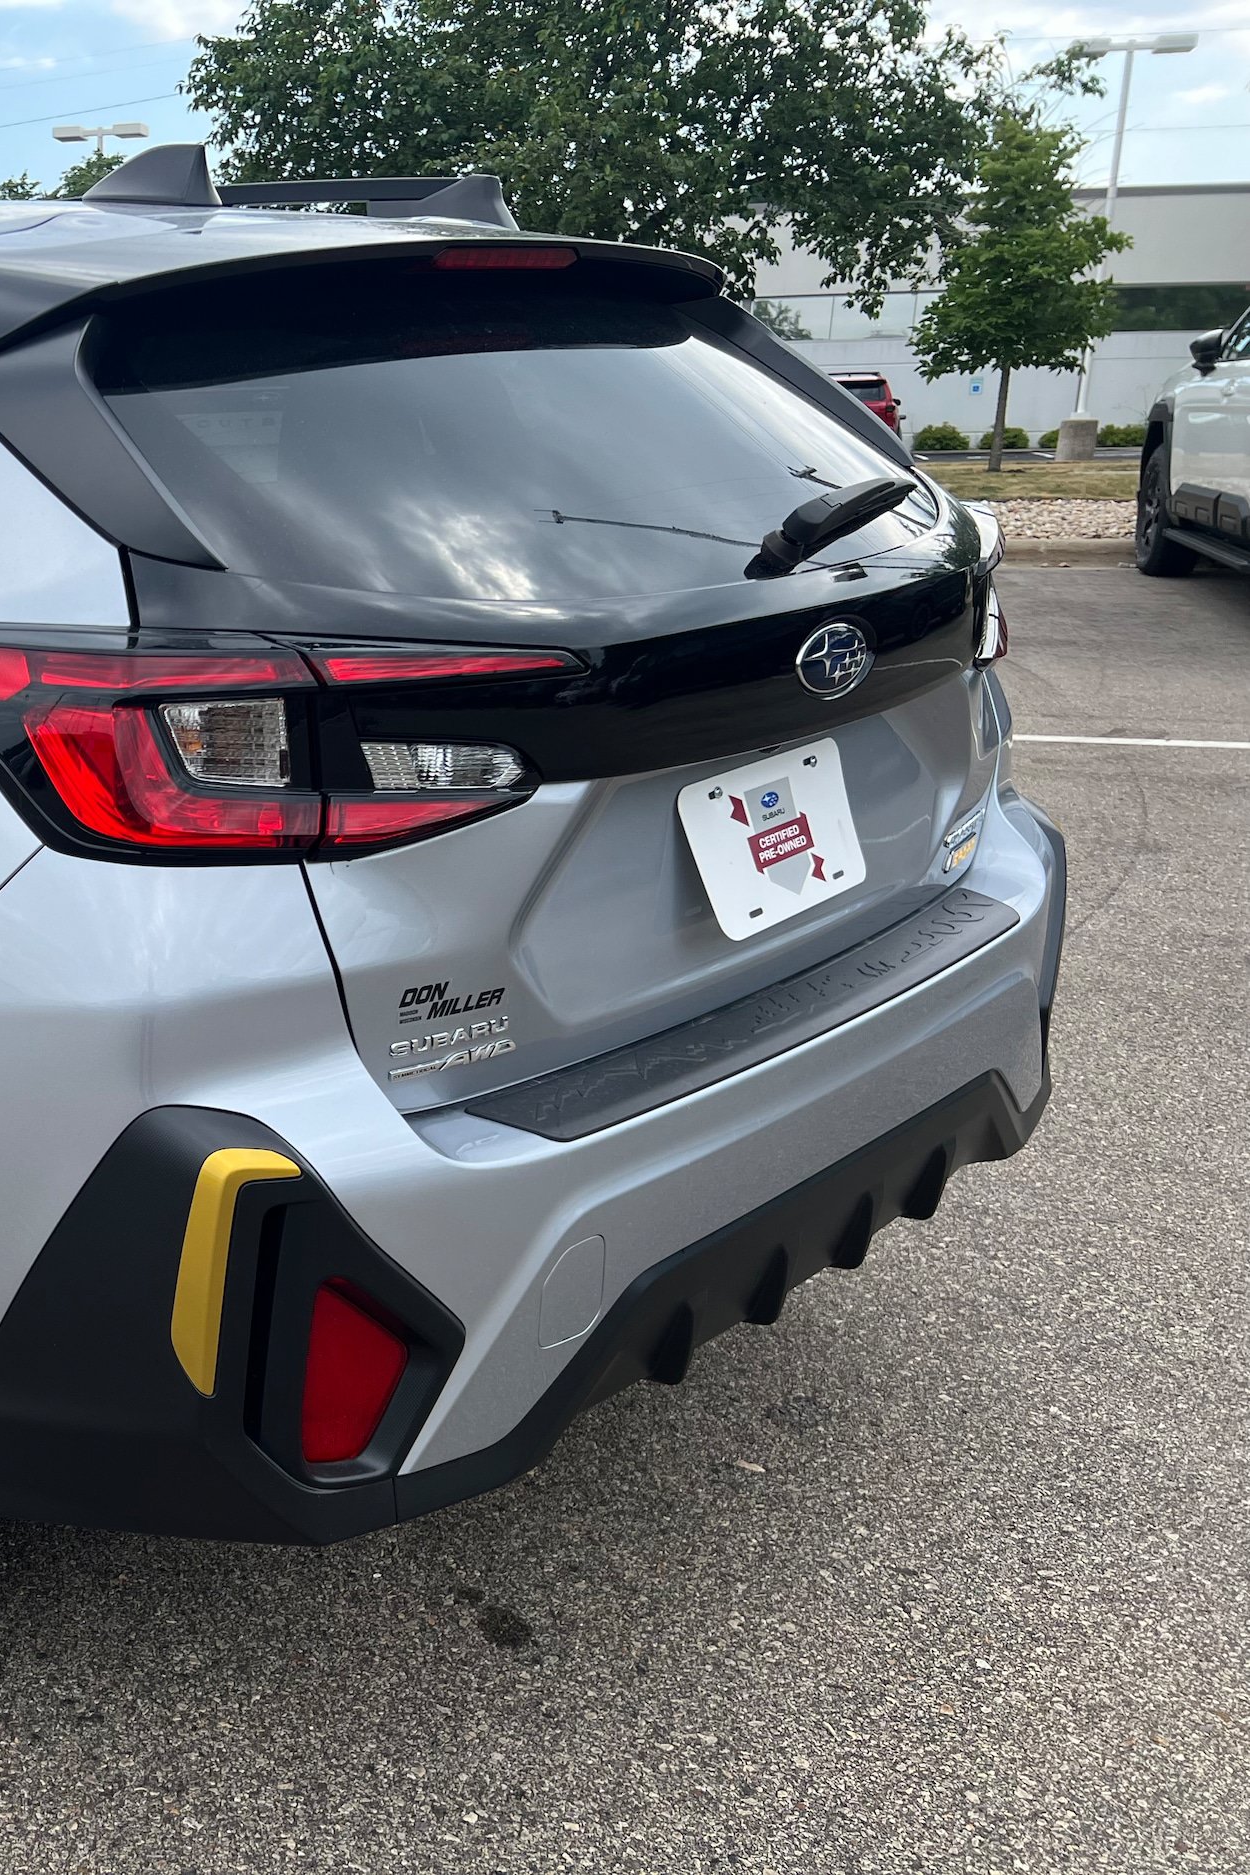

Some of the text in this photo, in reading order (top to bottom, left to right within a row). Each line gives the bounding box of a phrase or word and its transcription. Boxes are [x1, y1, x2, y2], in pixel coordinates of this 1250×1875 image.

[761, 807, 785, 821] SUBARU
[758, 834, 807, 863] PRE-OWNED
[759, 824, 800, 849] CERTIFIED
[398, 981, 450, 1008] DON
[426, 988, 506, 1020] MILLER
[389, 1016, 509, 1058] SUBARU
[439, 1038, 517, 1072] AWD
